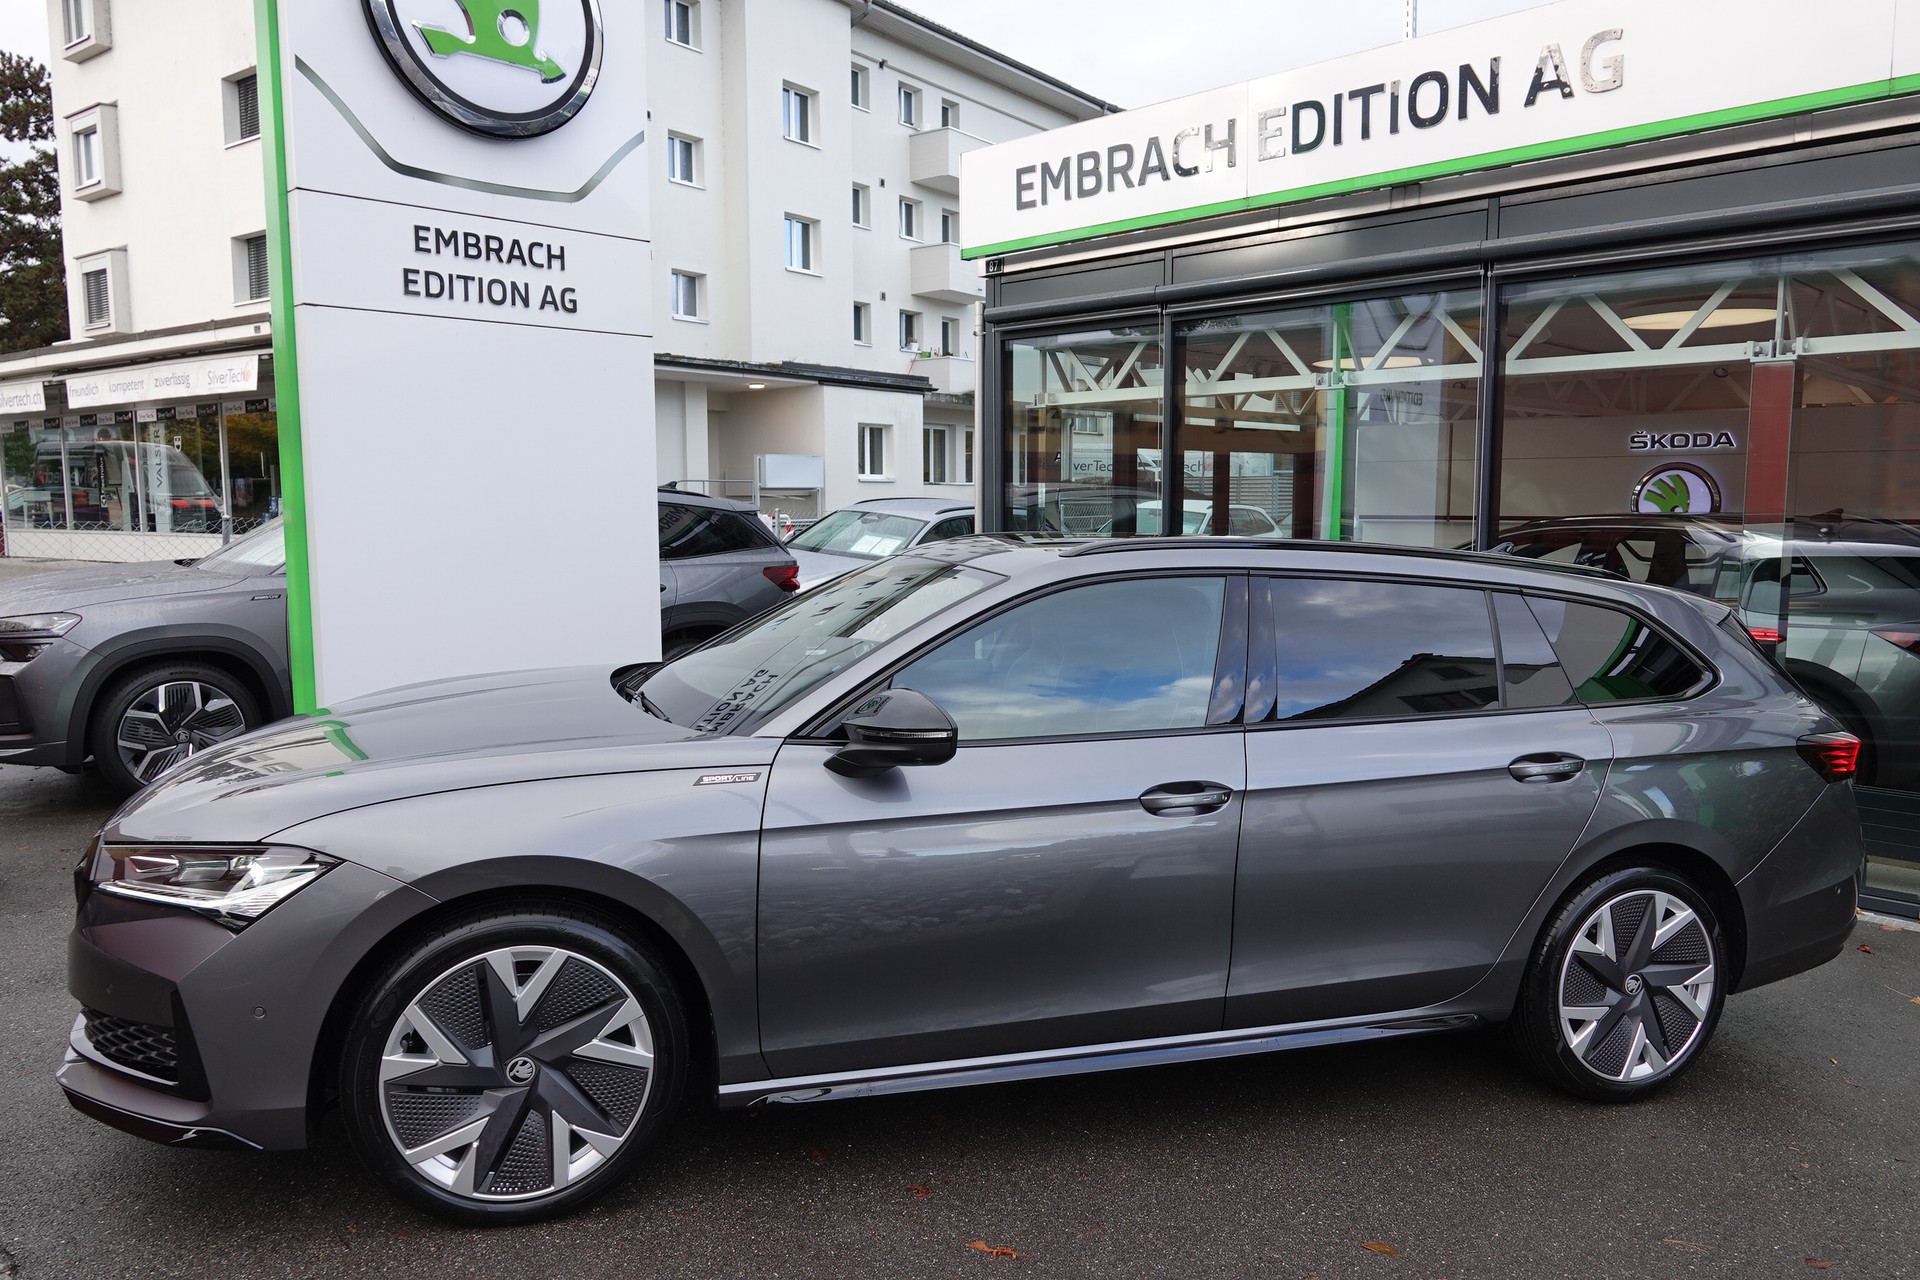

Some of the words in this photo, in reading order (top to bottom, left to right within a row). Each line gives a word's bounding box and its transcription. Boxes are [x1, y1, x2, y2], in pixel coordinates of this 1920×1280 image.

[1015, 117, 1237, 211] EMBRACH
[1257, 55, 1501, 162] EDITION
[1523, 27, 1625, 108] AG
[413, 224, 566, 271] EMBRACH
[989, 260, 999, 272] 87
[402, 267, 530, 309] EDITION
[539, 284, 578, 314] AG
[68, 382, 99, 398] freundlich
[109, 378, 145, 395] kompetent
[154, 371, 191, 389] zuverlässig
[207, 368, 246, 386] SilverTech
[1629, 430, 1736, 450] ŠKODA
